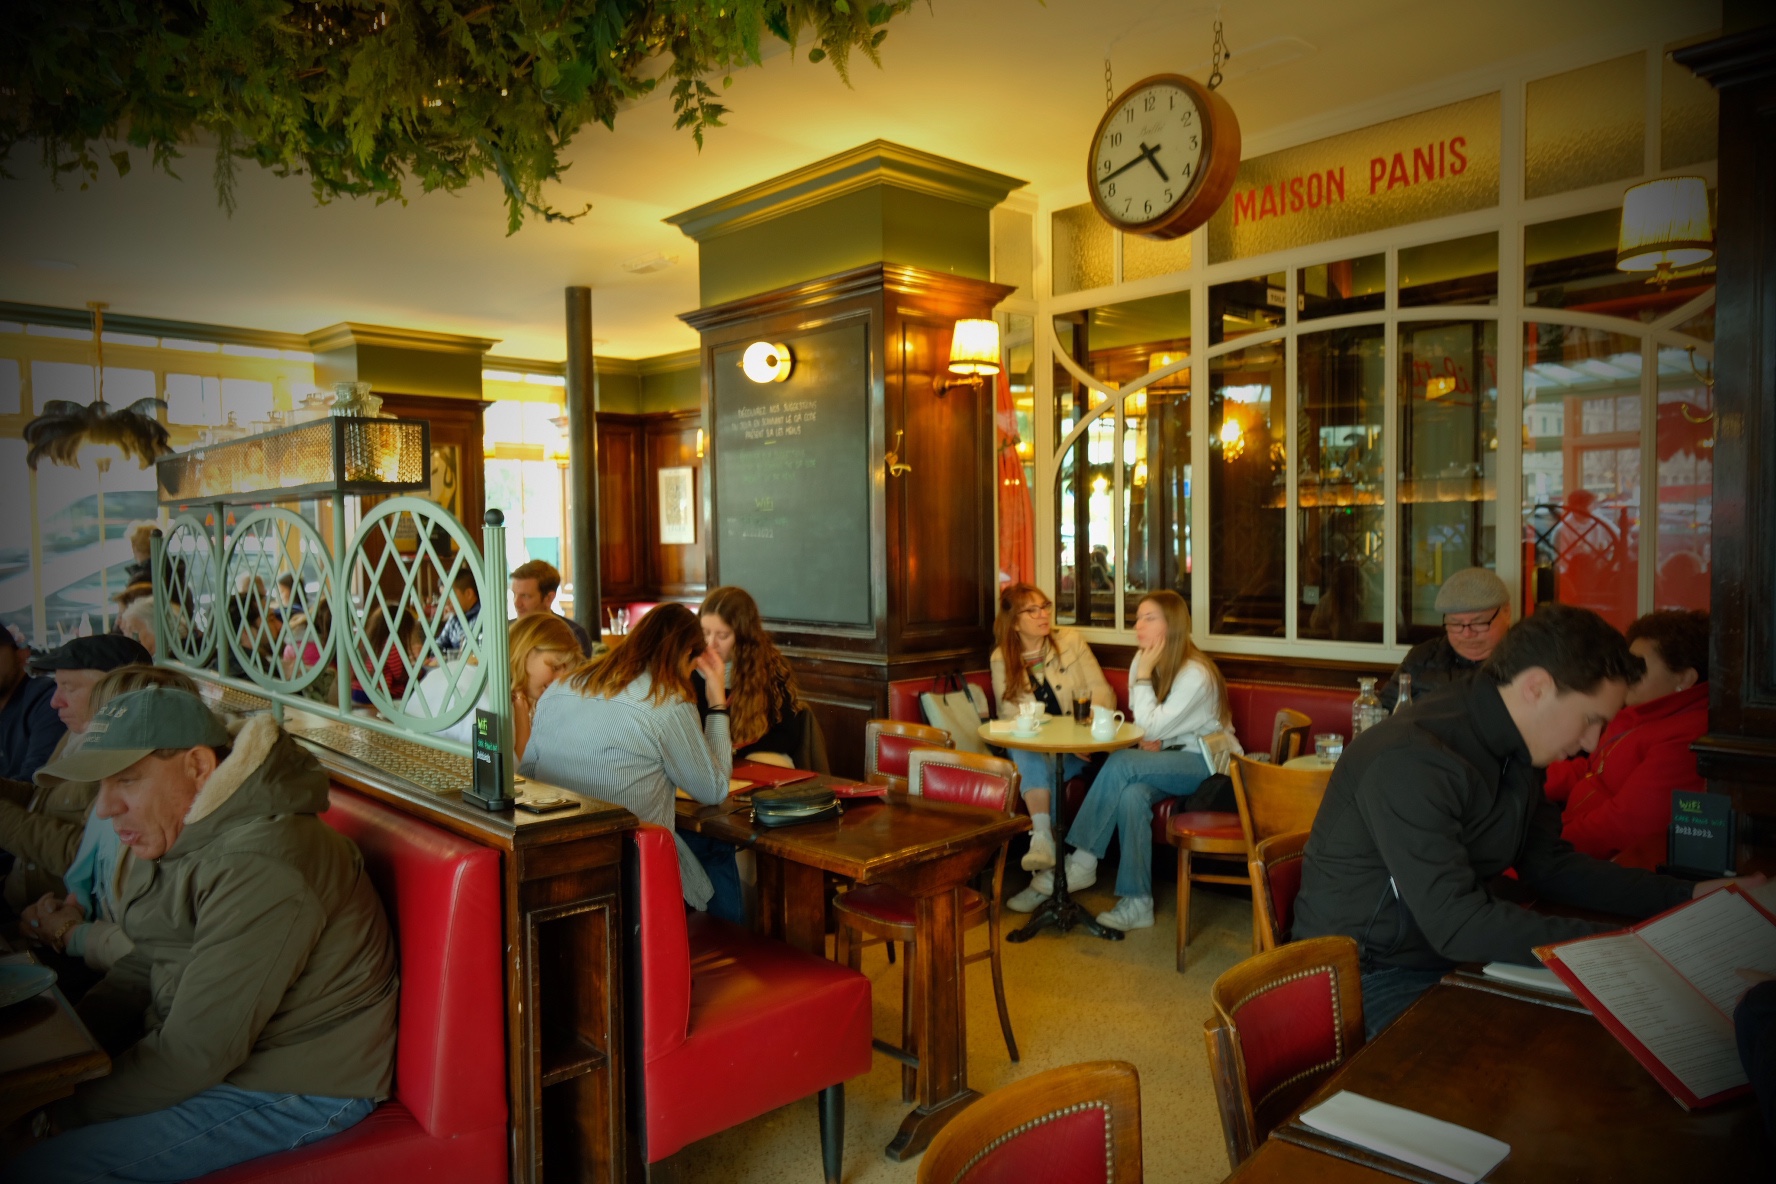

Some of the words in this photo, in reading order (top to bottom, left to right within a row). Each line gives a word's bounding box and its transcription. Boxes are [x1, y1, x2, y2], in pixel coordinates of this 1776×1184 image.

[1144, 96, 1156, 112] 12
[1169, 96, 1175, 111] 1
[1126, 108, 1134, 124] 11
[1181, 111, 1192, 127] 2
[1110, 132, 1122, 148] 10
[1189, 135, 1198, 151] 3
[1104, 160, 1111, 174] 9
[1182, 163, 1191, 178] 4
[1233, 166, 1345, 227] MAISON
[1369, 136, 1468, 195] PANIS
[1108, 183, 1116, 197] 8
[1164, 188, 1173, 203] 5
[1124, 198, 1132, 214] 7
[1144, 200, 1152, 215] 6
